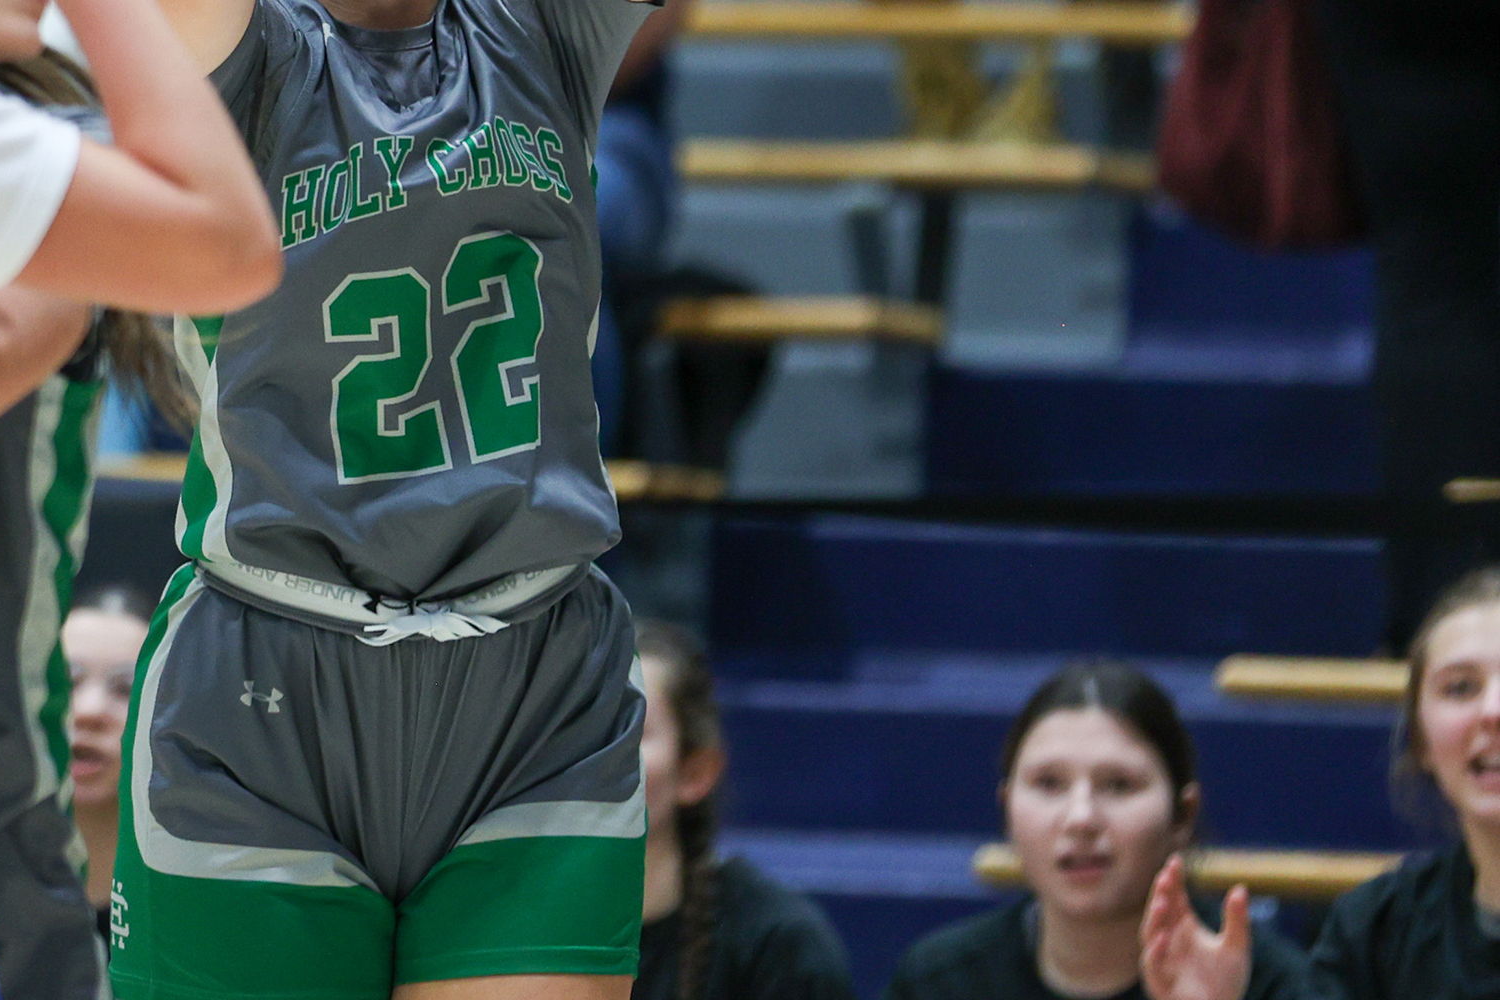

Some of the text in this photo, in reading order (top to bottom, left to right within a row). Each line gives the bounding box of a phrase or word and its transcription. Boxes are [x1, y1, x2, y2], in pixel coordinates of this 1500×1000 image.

[280, 116, 573, 250] HOLY CROSS
[322, 230, 544, 485] 22
[285, 573, 357, 603] UNDER
